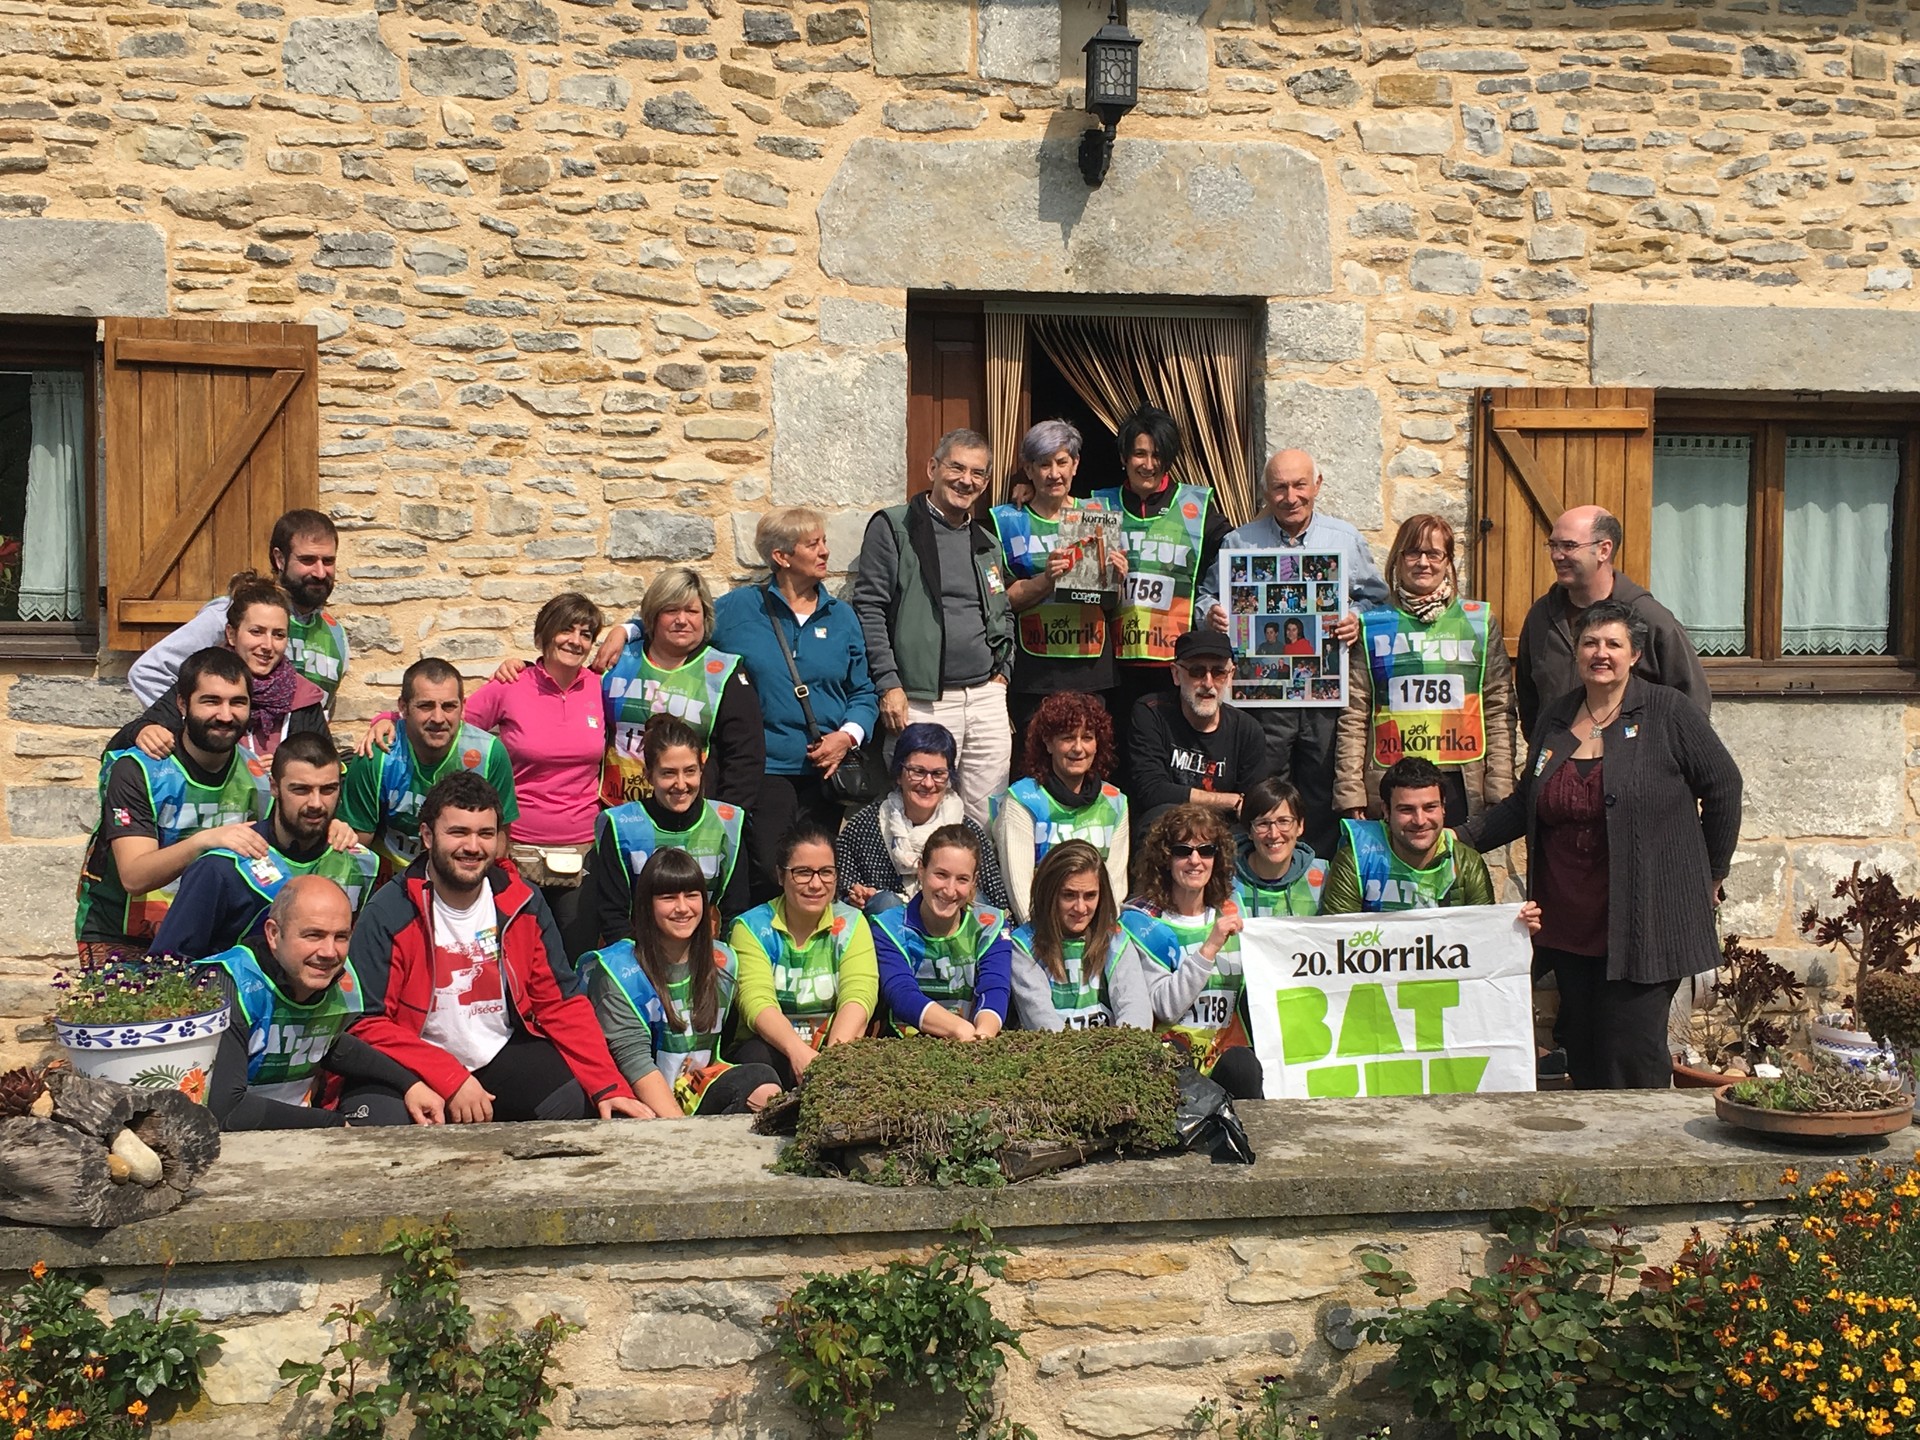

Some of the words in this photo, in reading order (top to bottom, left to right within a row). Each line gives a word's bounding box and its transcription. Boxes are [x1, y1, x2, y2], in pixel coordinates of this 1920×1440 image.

[1081, 512, 1117, 525] korrika
[1124, 577, 1163, 603] 1758
[1400, 679, 1452, 704] 1758
[1401, 729, 1477, 751] korrika
[1408, 722, 1430, 736] aek
[1348, 924, 1383, 948] aek
[1291, 952, 1333, 978] 20.
[1336, 934, 1471, 974] korrika
[1188, 996, 1228, 1024] 1758
[1276, 979, 1459, 1065] BAT
